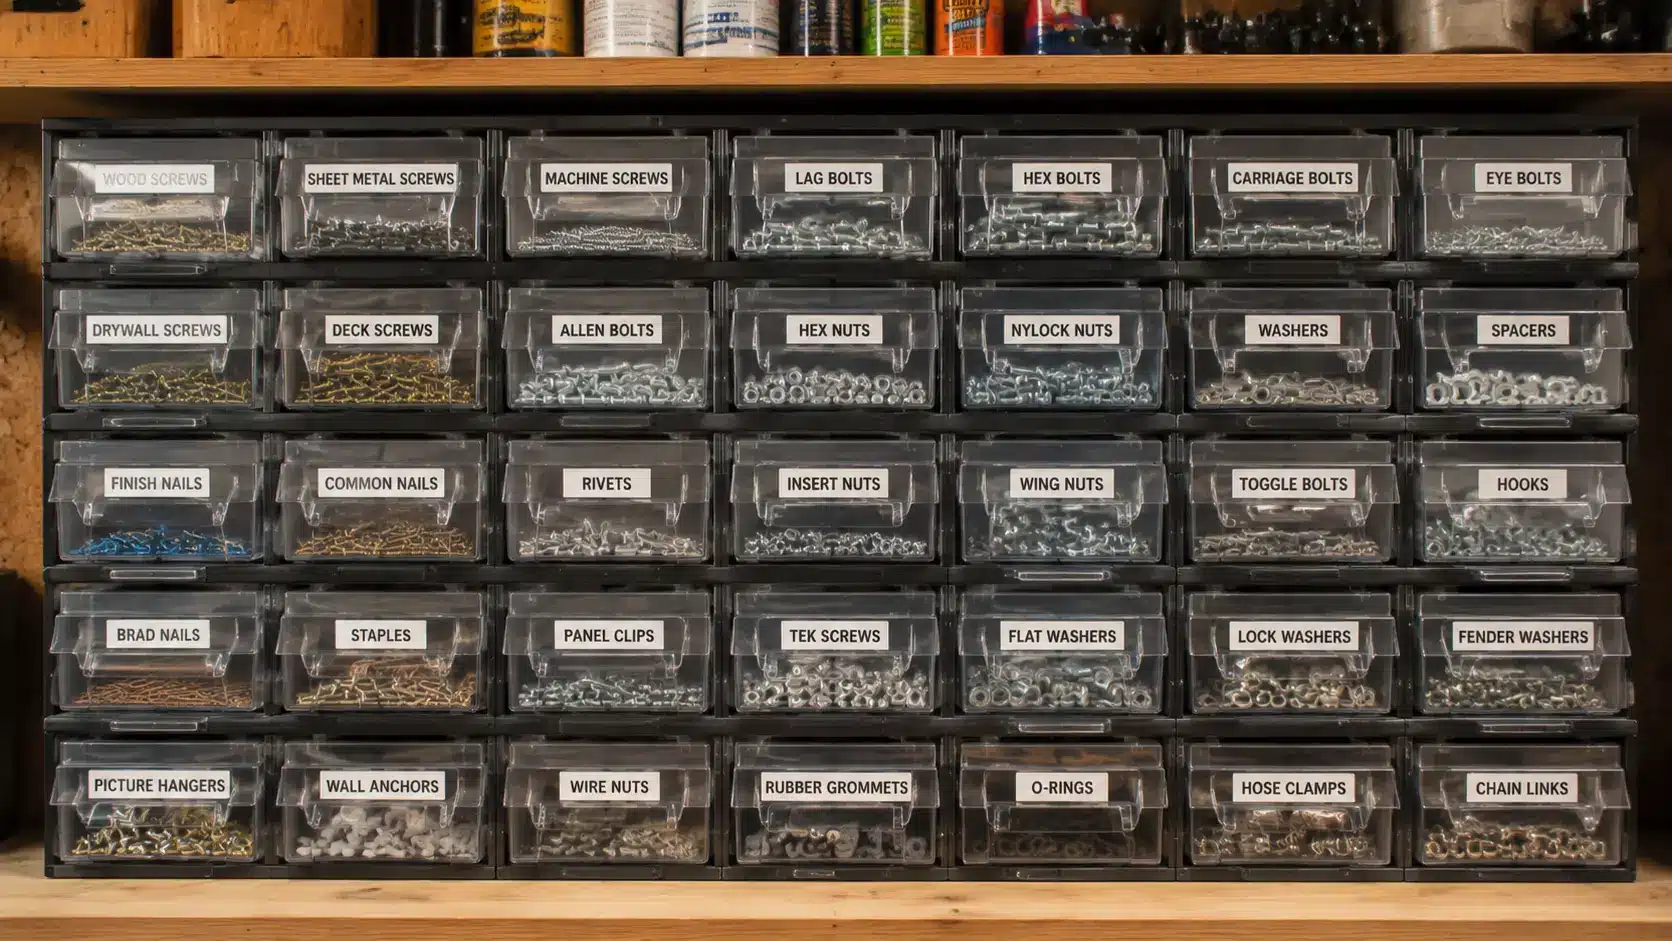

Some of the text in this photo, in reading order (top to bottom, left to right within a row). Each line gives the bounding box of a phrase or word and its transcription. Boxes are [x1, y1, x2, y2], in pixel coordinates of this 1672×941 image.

[102, 172, 209, 187] WOOD SCREWS
[307, 172, 455, 186] SHEET METAL SCREWS
[545, 171, 668, 186] MACHINE SCREWS
[795, 171, 873, 185] LAG BOLTS
[1023, 171, 1101, 185] HEX BOLTS
[1232, 171, 1354, 185] CARRIAGE BOLTS
[1486, 171, 1562, 186] EYE BOLTS
[92, 323, 222, 337] DRYWALL SCREWS
[332, 323, 433, 337] DECK SCREWS
[559, 323, 655, 337] ALLEN BOLTS
[799, 323, 871, 338] HEX NUTS
[1011, 323, 1113, 338] NYLOCK NUTS
[1257, 323, 1329, 338] WASHERS
[1491, 323, 1557, 338] SPACERS
[111, 476, 203, 491] FINISH NAILS
[324, 476, 439, 491] COMMON NAILS
[582, 476, 632, 491] RIVETS
[787, 476, 881, 491] INSERT NUTS
[1019, 476, 1104, 491] WING NUTS
[1238, 476, 1349, 492] TOGGLE BOLTS
[1497, 477, 1549, 492] HOOKS
[117, 628, 201, 642] BRAD NAILS
[351, 628, 412, 642] STAPLES
[564, 628, 655, 643] PANEL CLIPS
[789, 629, 881, 643] TEK SCREWS
[1008, 629, 1117, 644] FLAT WASHERS
[1238, 629, 1352, 644] LOCK WASHERS
[1458, 630, 1589, 644] FENDER WASHERS
[94, 778, 226, 793] PICTURE HANGERS
[326, 779, 440, 794] WALL ANCHORS
[569, 780, 649, 794] WIRE NUTS
[765, 780, 909, 795] RUBBER GROMMETS
[1031, 780, 1094, 795] O-RINGS
[1241, 781, 1347, 796] HOSE CLAMPS
[1475, 781, 1569, 796] CHAIN LINKS
